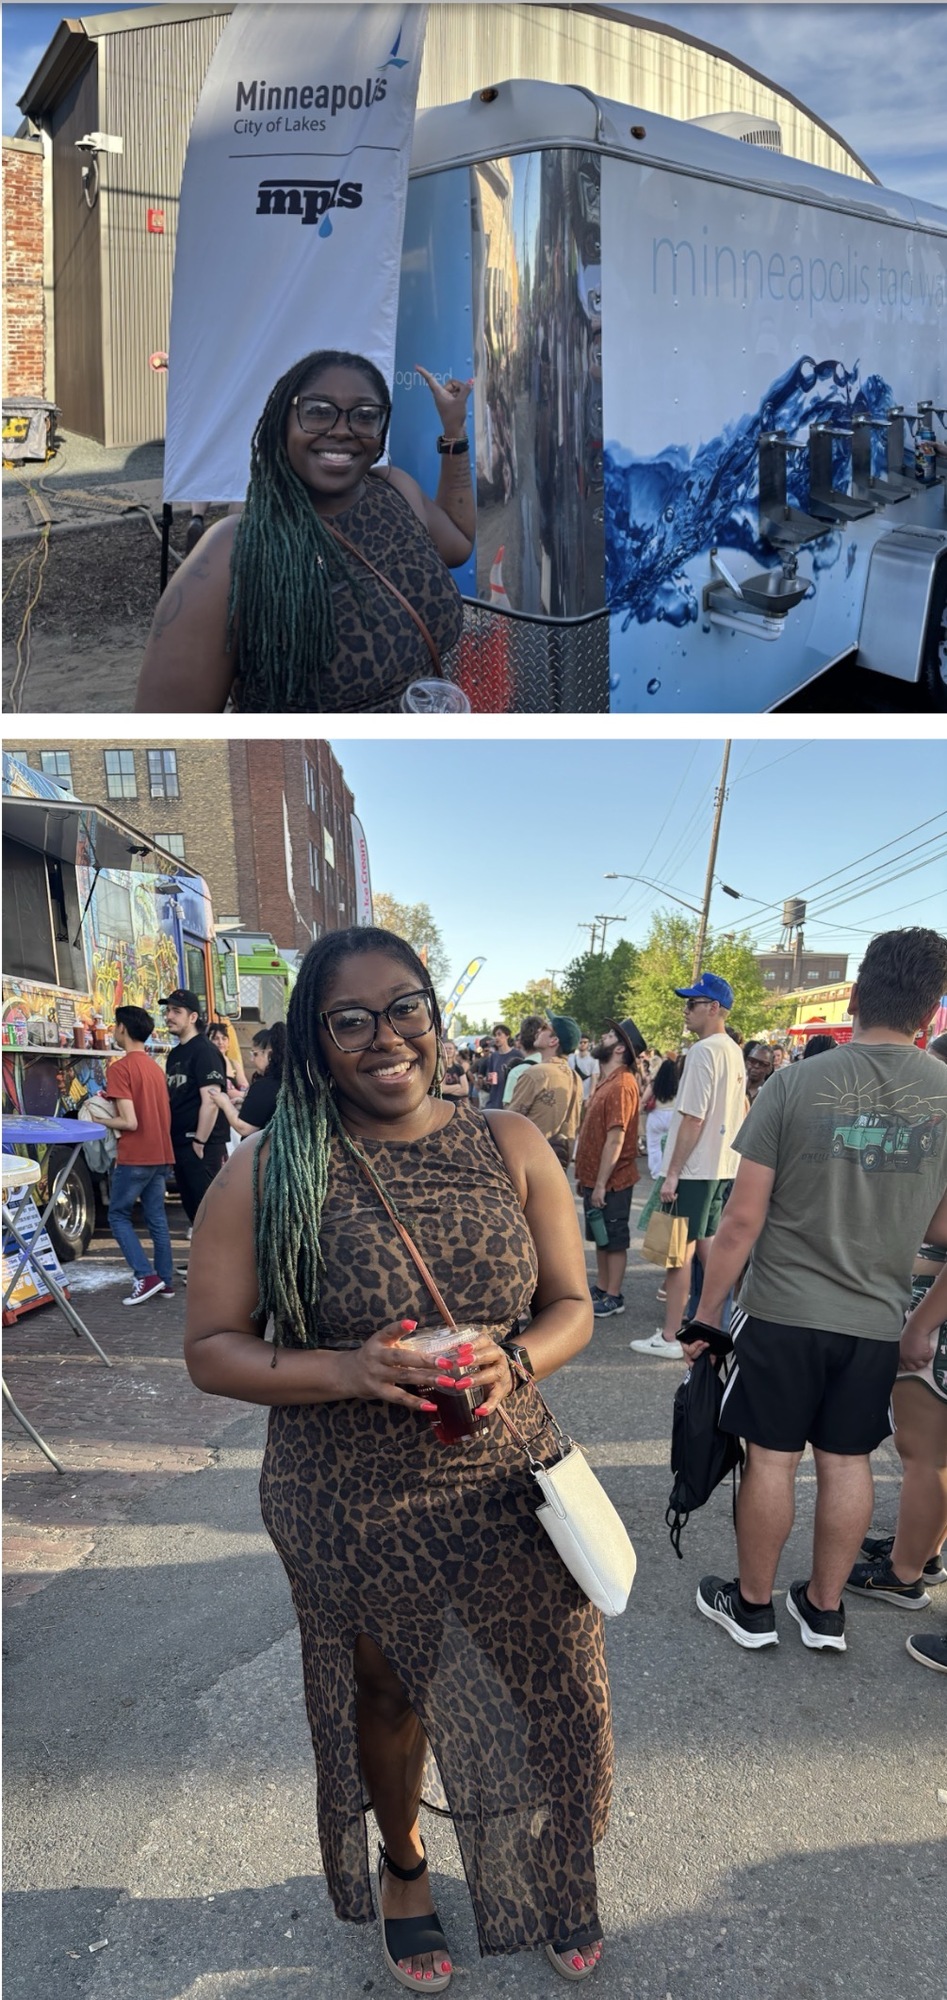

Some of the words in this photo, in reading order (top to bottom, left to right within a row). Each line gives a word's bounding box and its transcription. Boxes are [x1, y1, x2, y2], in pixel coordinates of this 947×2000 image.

[235, 77, 388, 117] Minneapolis
[233, 118, 263, 137] City
[266, 116, 283, 133] of
[285, 116, 327, 132] Lakes
[653, 224, 870, 318] minneapolis
[877, 256, 912, 320] tap
[360, 839, 368, 884] Cream
